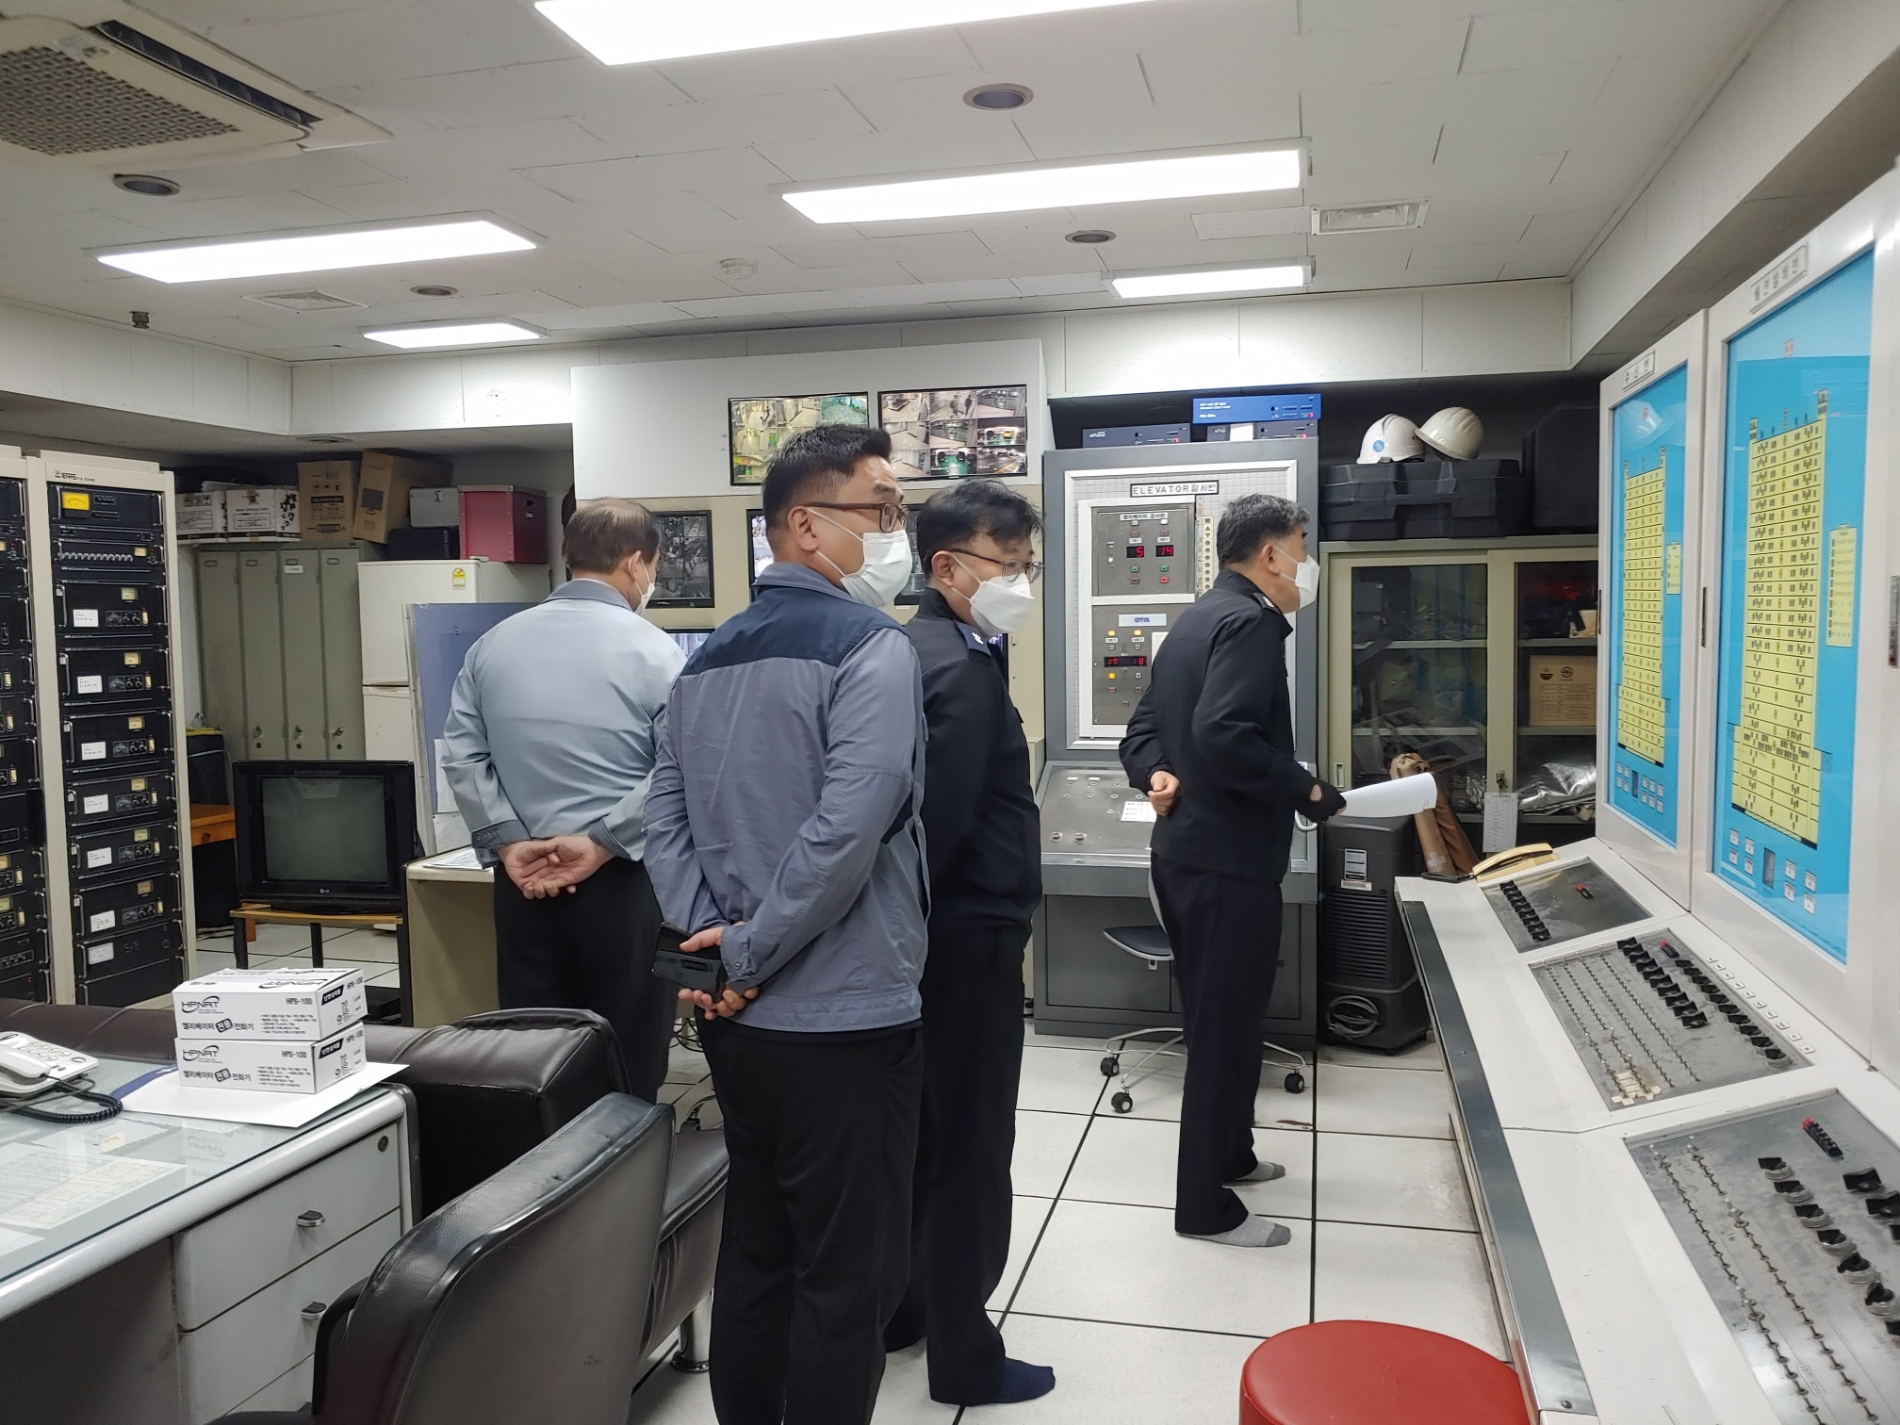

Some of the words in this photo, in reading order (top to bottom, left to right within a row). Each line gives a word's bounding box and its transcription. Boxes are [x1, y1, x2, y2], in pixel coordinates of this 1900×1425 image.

[1136, 546, 1143, 558] 5
[1161, 546, 1173, 556] 14
[285, 997, 313, 1005] HPS-100
[182, 1022, 215, 1030] 엘리베이터
[281, 1051, 307, 1059] HPS-100
[183, 1070, 214, 1079] 엘리베이터
[232, 1073, 252, 1081] 전화기
